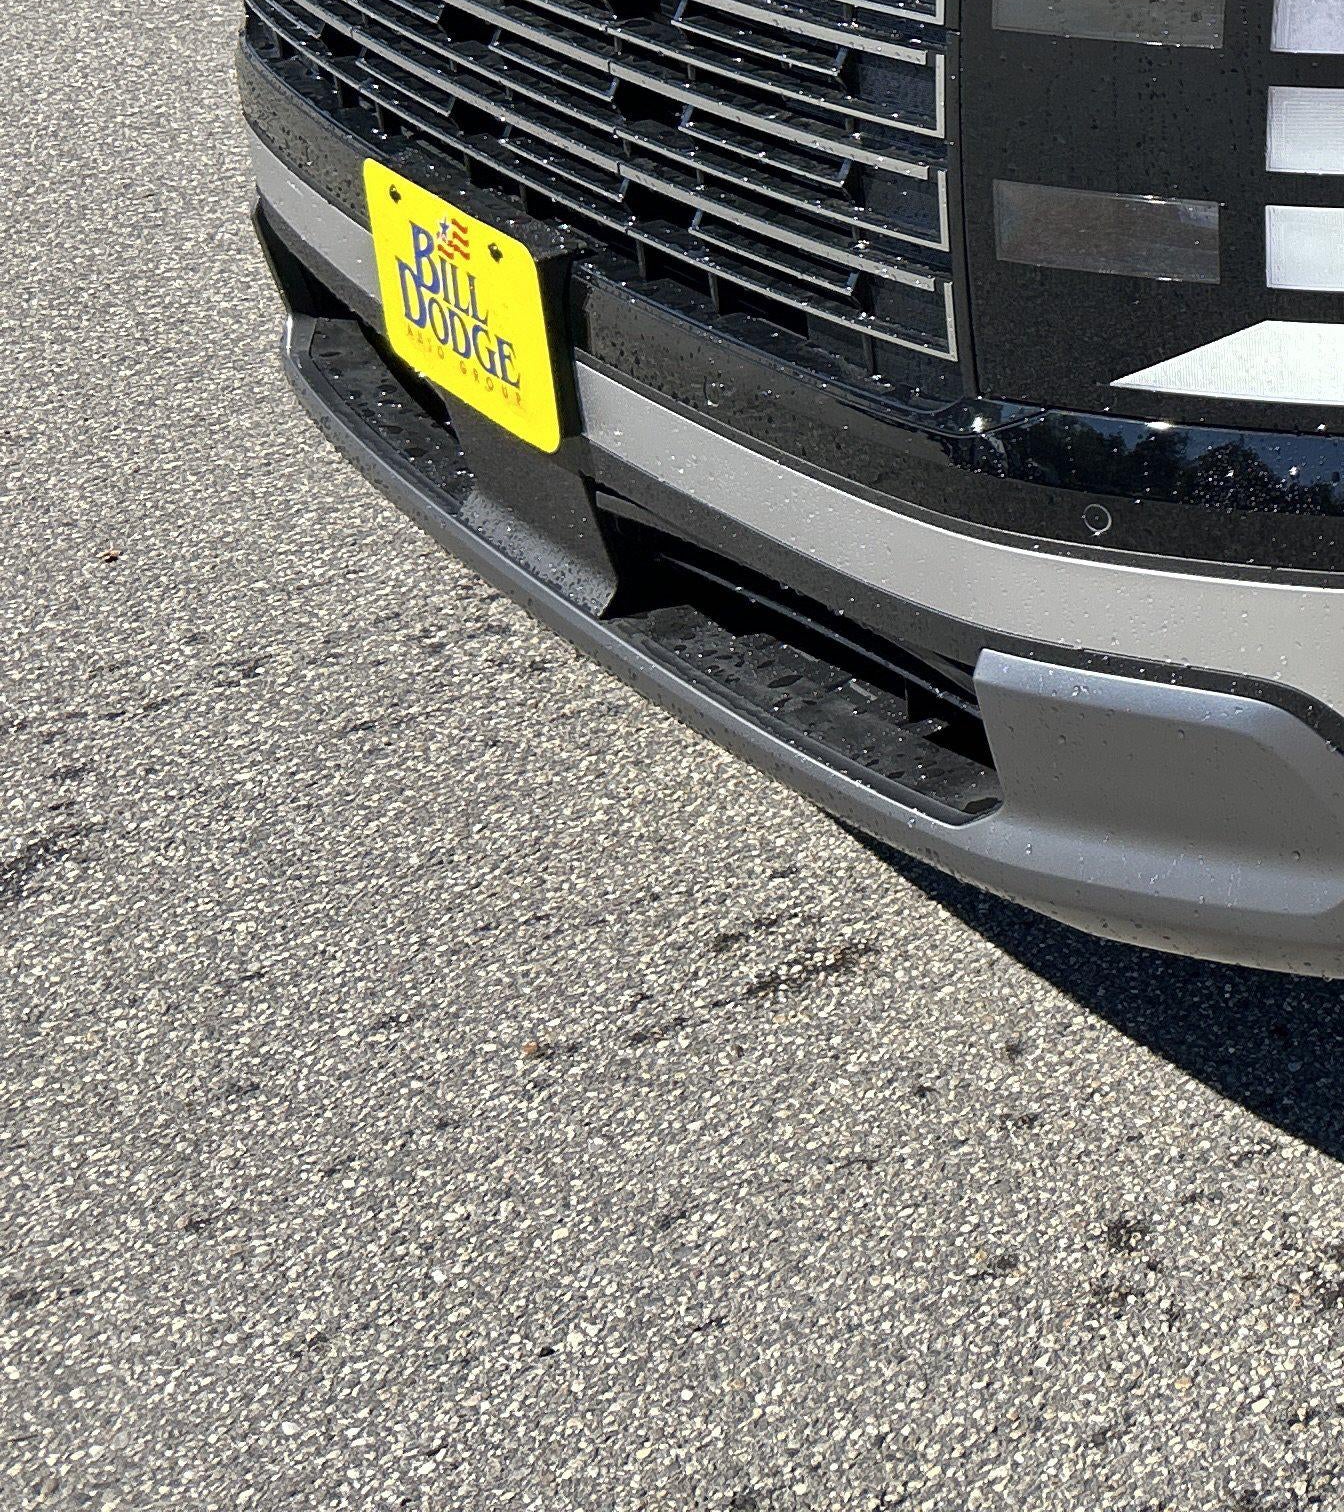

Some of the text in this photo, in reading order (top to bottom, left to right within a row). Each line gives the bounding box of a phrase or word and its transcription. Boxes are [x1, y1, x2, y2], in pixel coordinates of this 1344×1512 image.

[395, 254, 521, 390] DODGE
[409, 219, 489, 327] BILL
[459, 360, 522, 409] GROUP
